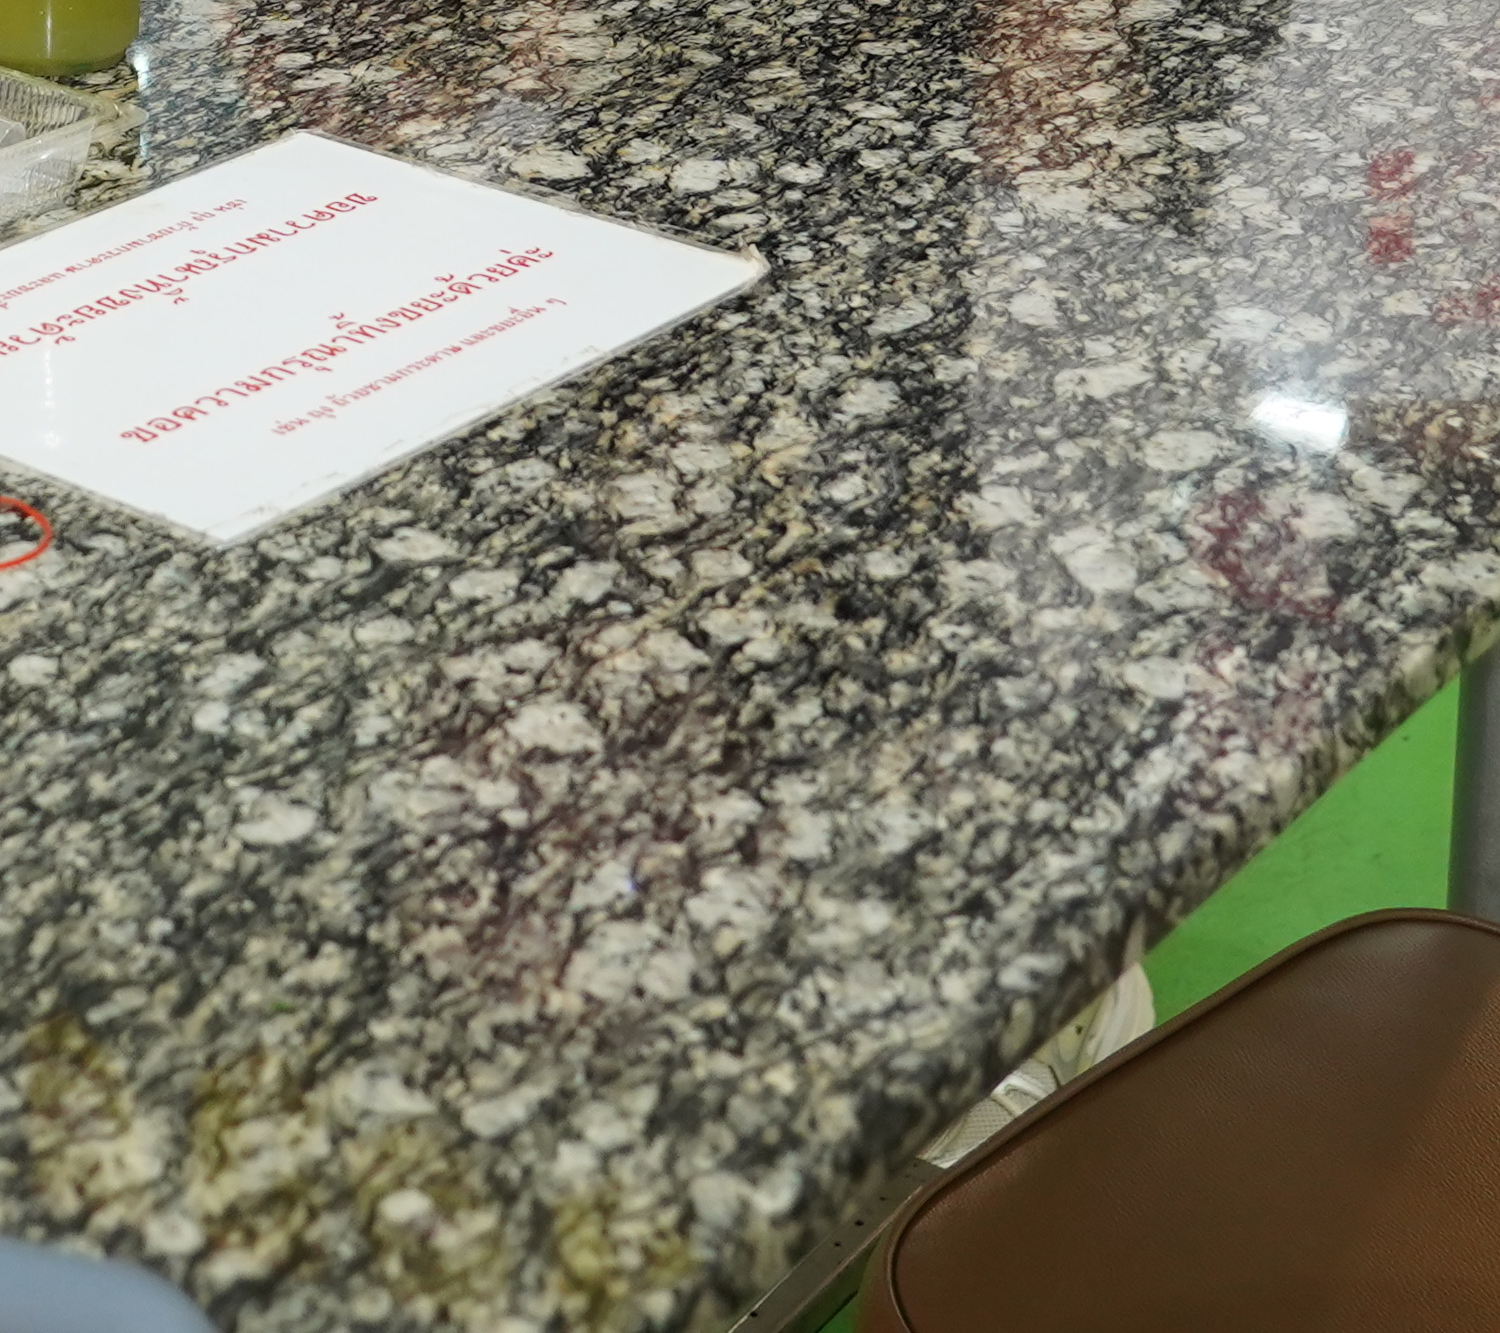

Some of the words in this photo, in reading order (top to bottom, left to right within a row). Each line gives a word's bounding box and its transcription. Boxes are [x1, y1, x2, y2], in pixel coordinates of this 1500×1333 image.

[119, 245, 556, 445] ขอความกรุณาทิ้งขยะด้วยค่ะ
